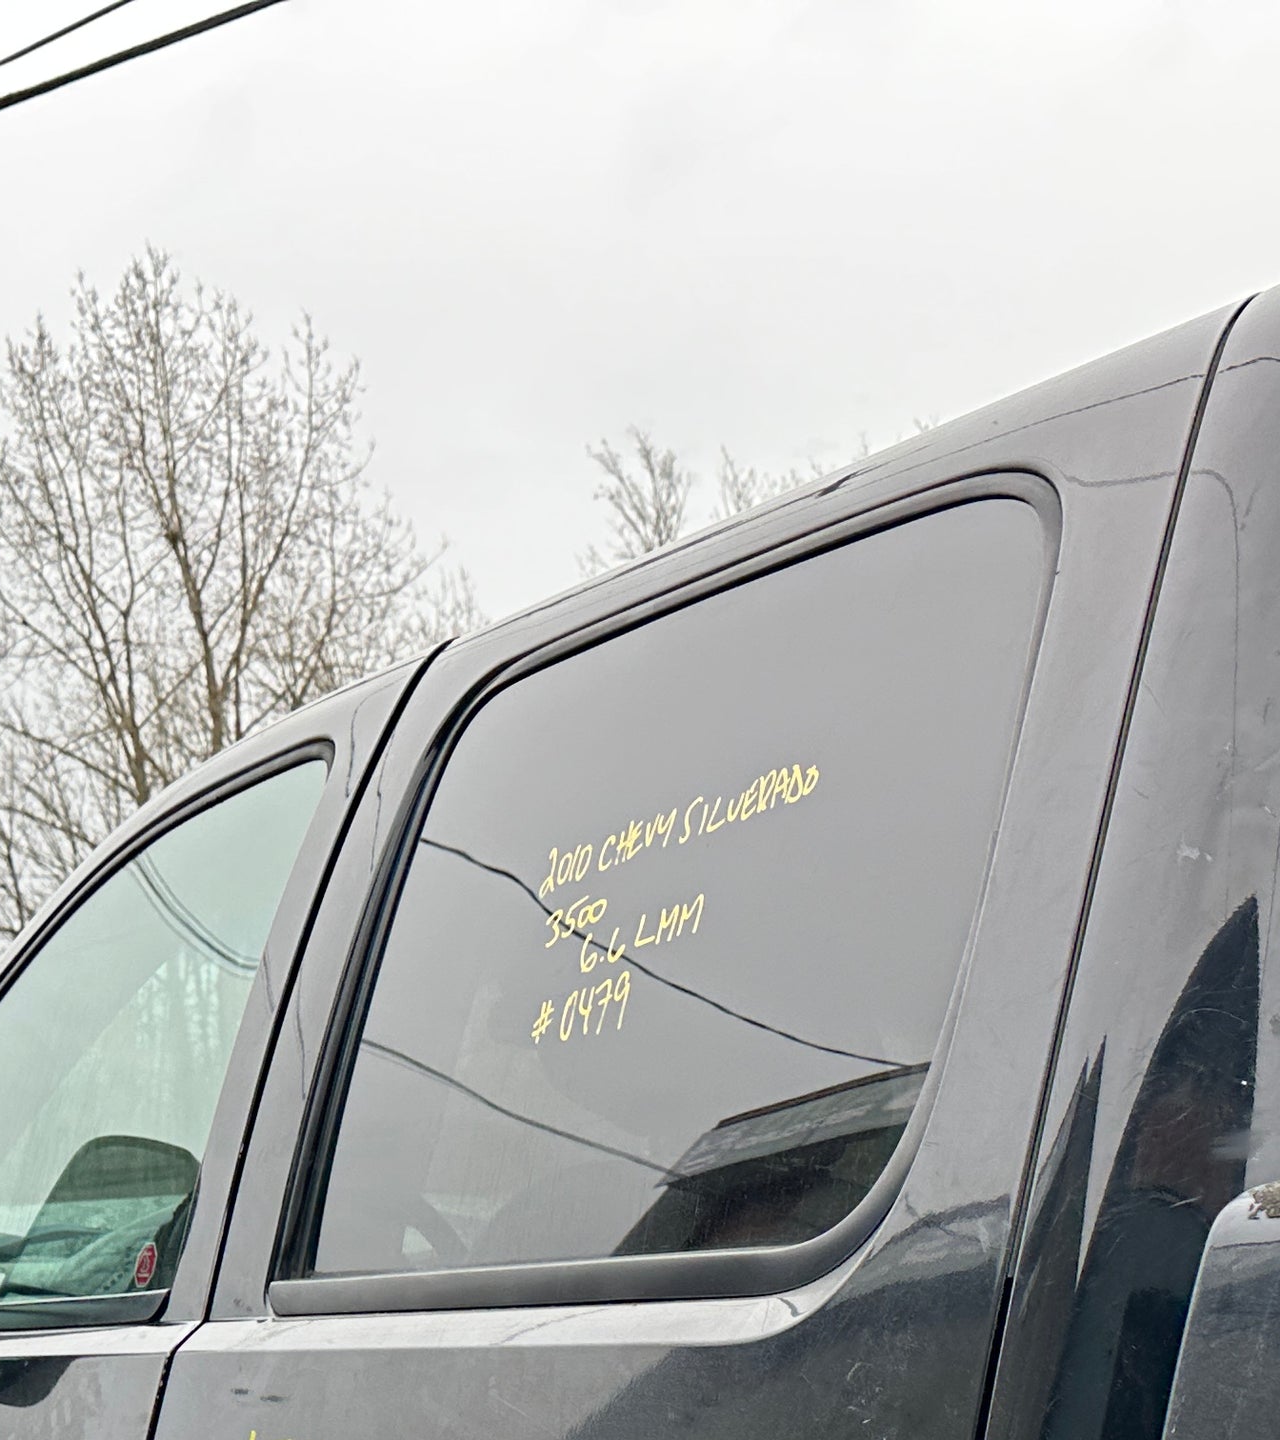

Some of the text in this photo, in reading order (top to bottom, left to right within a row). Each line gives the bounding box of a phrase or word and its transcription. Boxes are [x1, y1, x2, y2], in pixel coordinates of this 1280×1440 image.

[539, 764, 819, 899] 2010 CHEVY SILVERADO
[545, 895, 607, 948] 3500
[580, 893, 705, 973] 6.6 LMM
